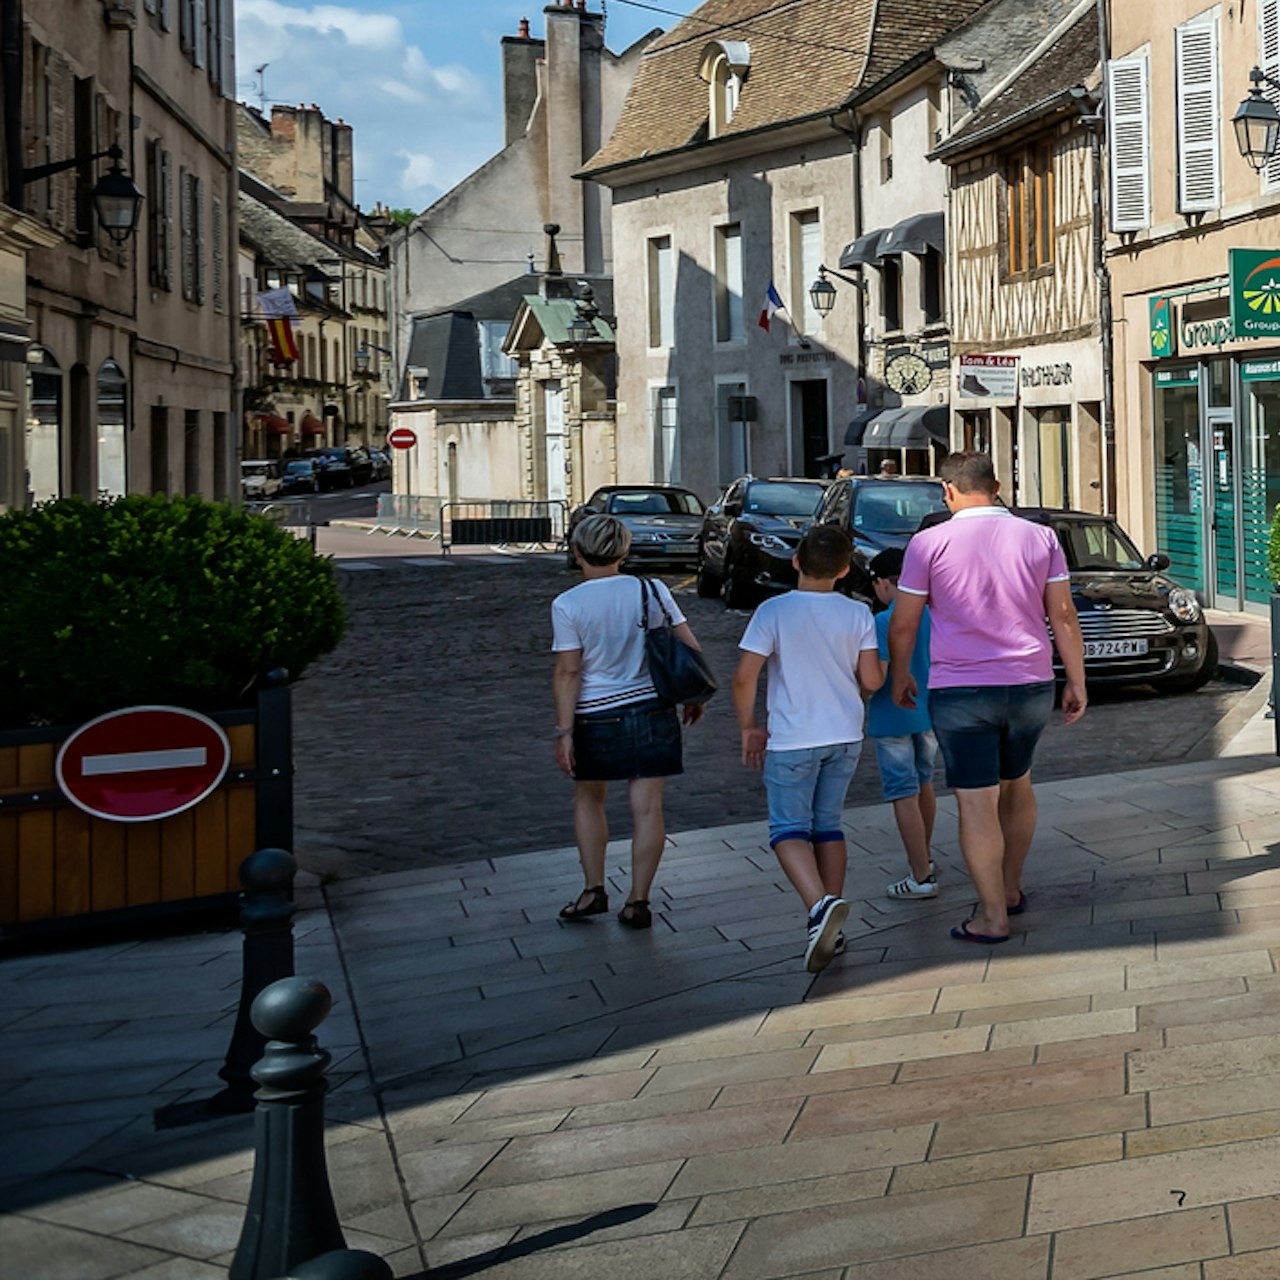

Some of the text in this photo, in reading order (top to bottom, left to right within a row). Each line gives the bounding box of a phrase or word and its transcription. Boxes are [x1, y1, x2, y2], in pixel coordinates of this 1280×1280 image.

[961, 356, 1015, 367] Tom & Léa
